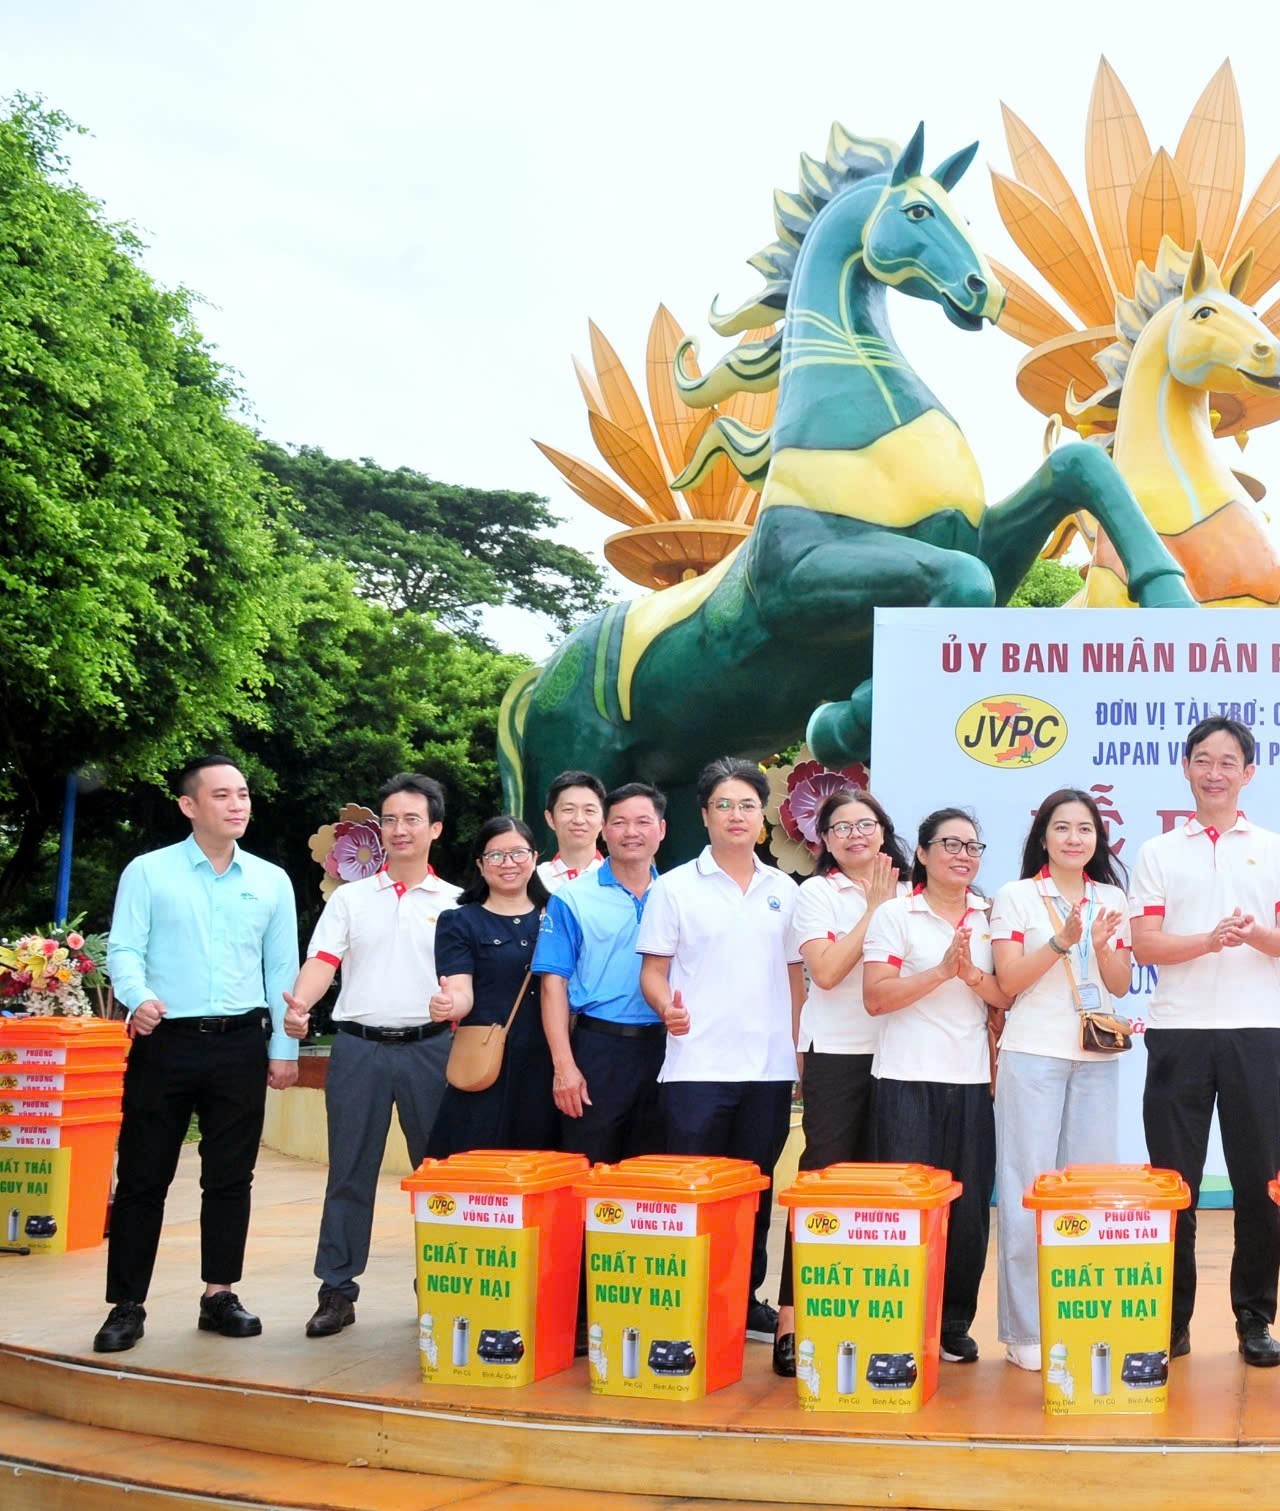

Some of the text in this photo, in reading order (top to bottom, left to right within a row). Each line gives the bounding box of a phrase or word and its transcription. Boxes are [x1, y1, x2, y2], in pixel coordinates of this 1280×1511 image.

[941, 633, 988, 673] ỦY
[1001, 643, 1069, 673] BAN
[1082, 637, 1175, 673] NHÂN
[1188, 637, 1258, 673] DÂN
[1095, 698, 1137, 726] ĐƠN
[1146, 702, 1166, 731] VỊ
[1174, 696, 1209, 726] TÀI
[1217, 698, 1265, 731] TRỢ:
[964, 715, 1060, 749] JVPC
[1092, 741, 1160, 766] JAPAN
[24, 1159, 52, 1174] THẢI
[0, 1181, 48, 1196] GUY HẠI
[429, 1200, 454, 1211] JVPC
[469, 1193, 508, 1207] PHƯỜNG
[596, 1207, 622, 1219] JVPC
[636, 1202, 677, 1214] PHƯỜNG
[463, 1210, 514, 1224] VŨNG TÀU
[807, 1218, 838, 1229] JVPC
[854, 1211, 900, 1223] PHƯỜNG
[1104, 1210, 1151, 1222] PHƯỜNG
[630, 1218, 683, 1231] VŨNG TÀU
[1057, 1219, 1088, 1231] JVPC
[848, 1227, 906, 1240] VŨNG TÀU
[1098, 1226, 1158, 1240] VŨNG TÀU
[423, 1241, 517, 1268] CHẤT THẢI
[591, 1250, 686, 1277] CHẤT THẢI
[801, 1262, 909, 1287] CHẤT THẢI
[1051, 1262, 1162, 1287] CHẤT THẢI
[427, 1274, 510, 1300] NGUY HẠI
[595, 1284, 681, 1310] NGUY HẠI
[806, 1298, 903, 1322] NGUY HẠI
[1058, 1299, 1157, 1321] NGUY HẠI
